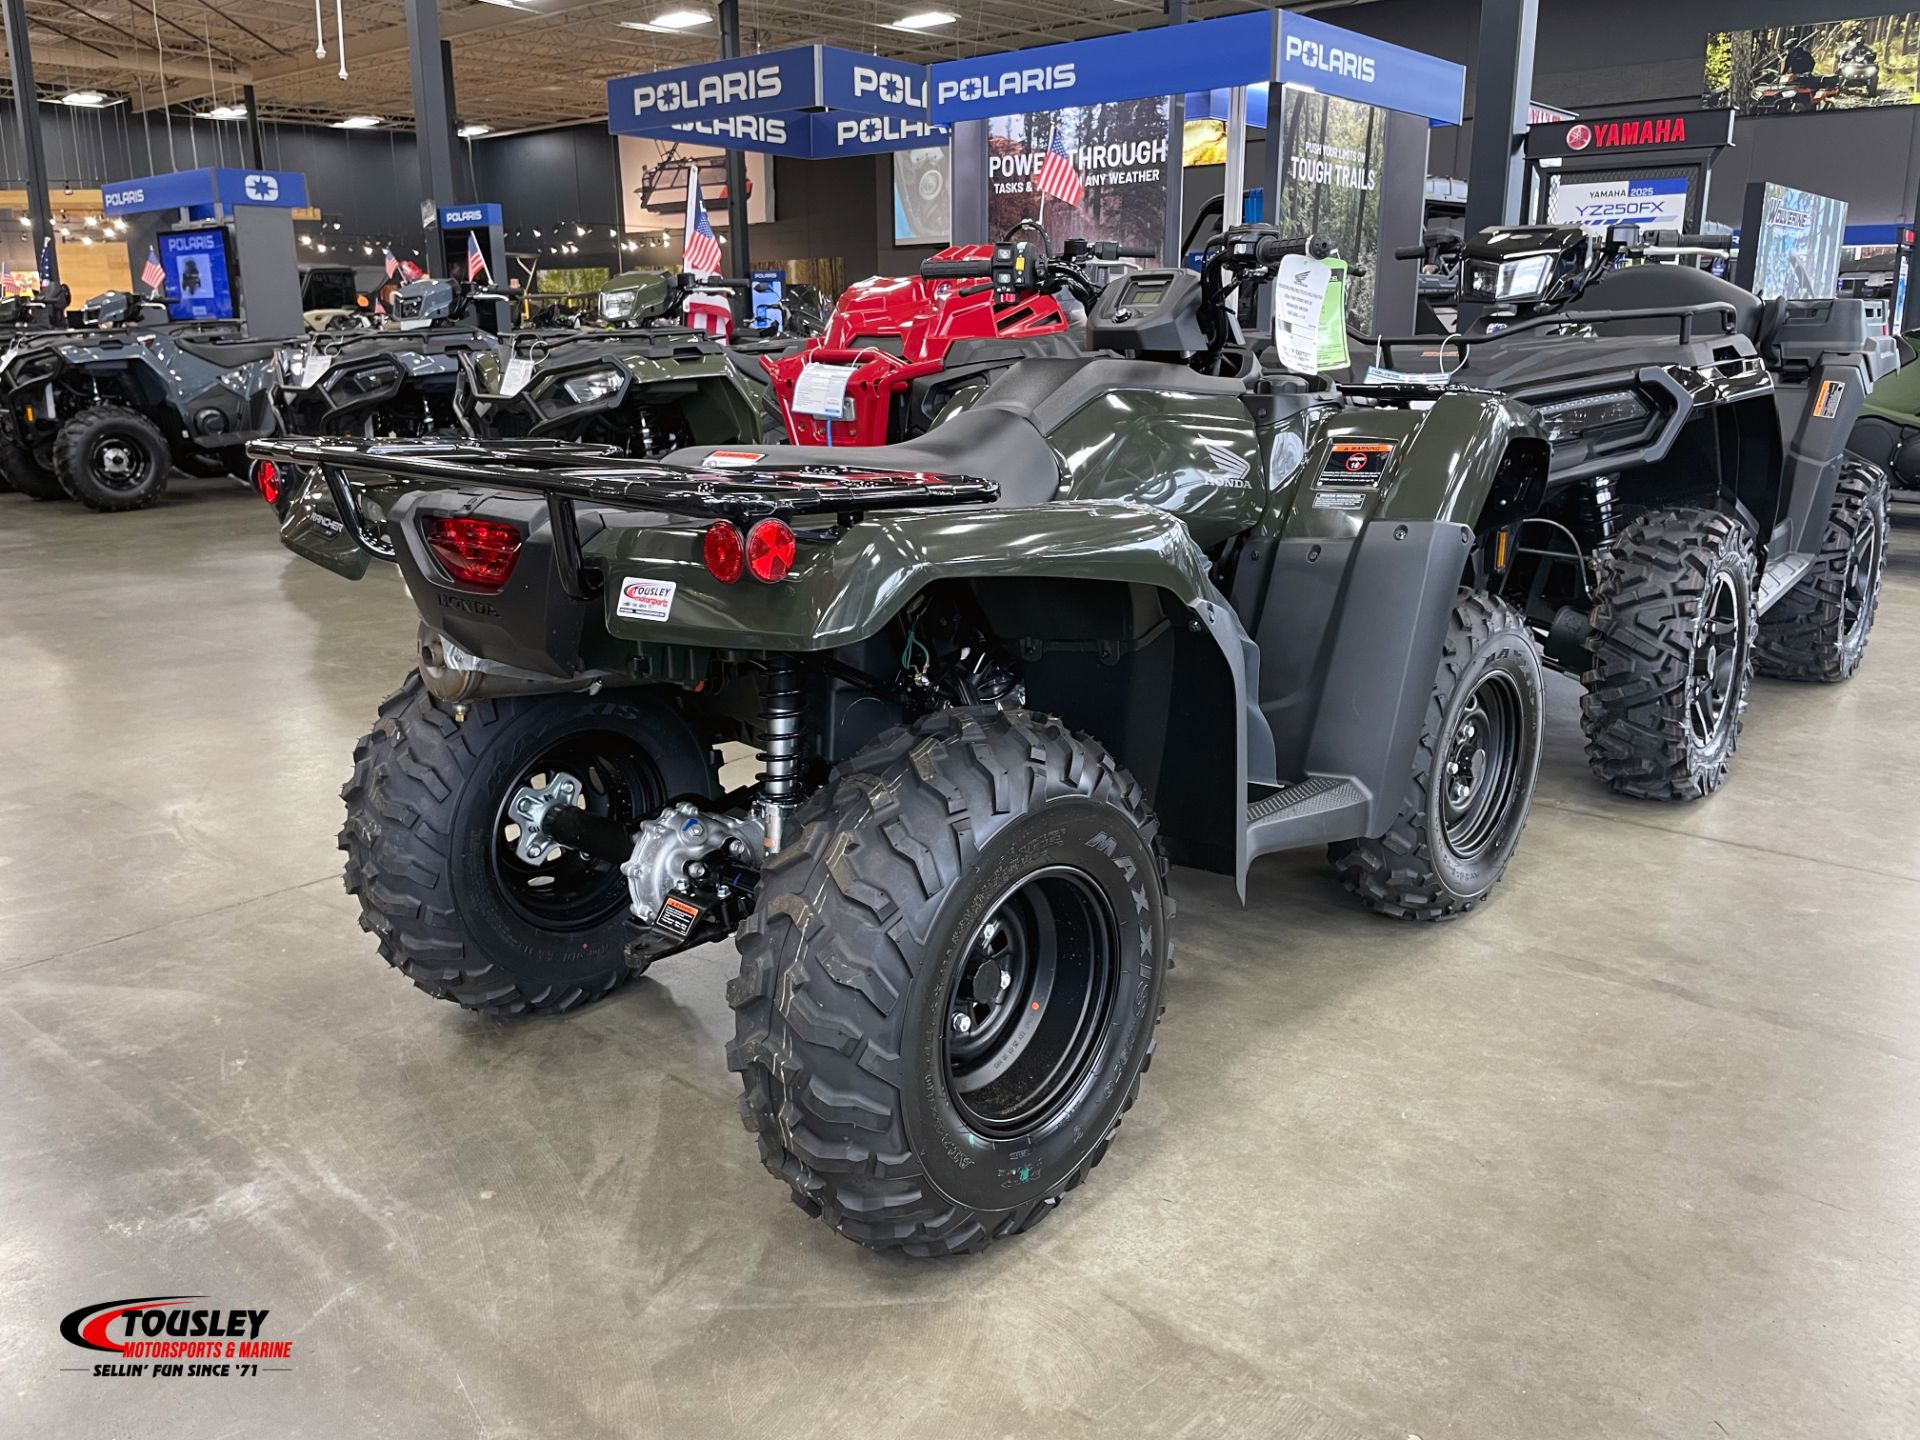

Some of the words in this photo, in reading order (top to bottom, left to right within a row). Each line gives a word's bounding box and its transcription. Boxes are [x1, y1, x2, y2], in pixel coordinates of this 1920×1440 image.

[1286, 35, 1375, 83] POLARIS
[634, 66, 782, 116] POLARIS
[854, 66, 927, 107] POL
[938, 63, 1077, 105] POLARIS
[1593, 118, 1685, 147] YAMAHA
[989, 152, 1047, 178] POWE
[1069, 139, 1168, 170] THROUGH
[1305, 141, 1322, 155] PUSH
[1322, 145, 1338, 157] YOUR
[1339, 148, 1357, 161] LIMITS
[1357, 152, 1366, 163] ON
[994, 182, 1024, 194] TASKS
[1025, 181, 1032, 192] &
[1085, 173, 1107, 187] ANY
[1108, 169, 1160, 185] WEATHER
[1291, 156, 1332, 185] TOUGH
[1335, 165, 1376, 190] TRAILS
[105, 189, 144, 207] POLARIS
[1589, 188, 1626, 199] YAMAHA
[1630, 187, 1654, 197] 2025
[446, 210, 482, 222] POLARIS
[1576, 201, 1665, 217] YZ250FX
[168, 235, 214, 251] POLARIS
[1205, 477, 1252, 489] HONDA
[310, 512, 344, 533] RANCHER
[633, 586, 672, 597] TOUSLEY
[437, 594, 500, 617] HONDA
[1085, 830, 1153, 1018] MAXXIS
